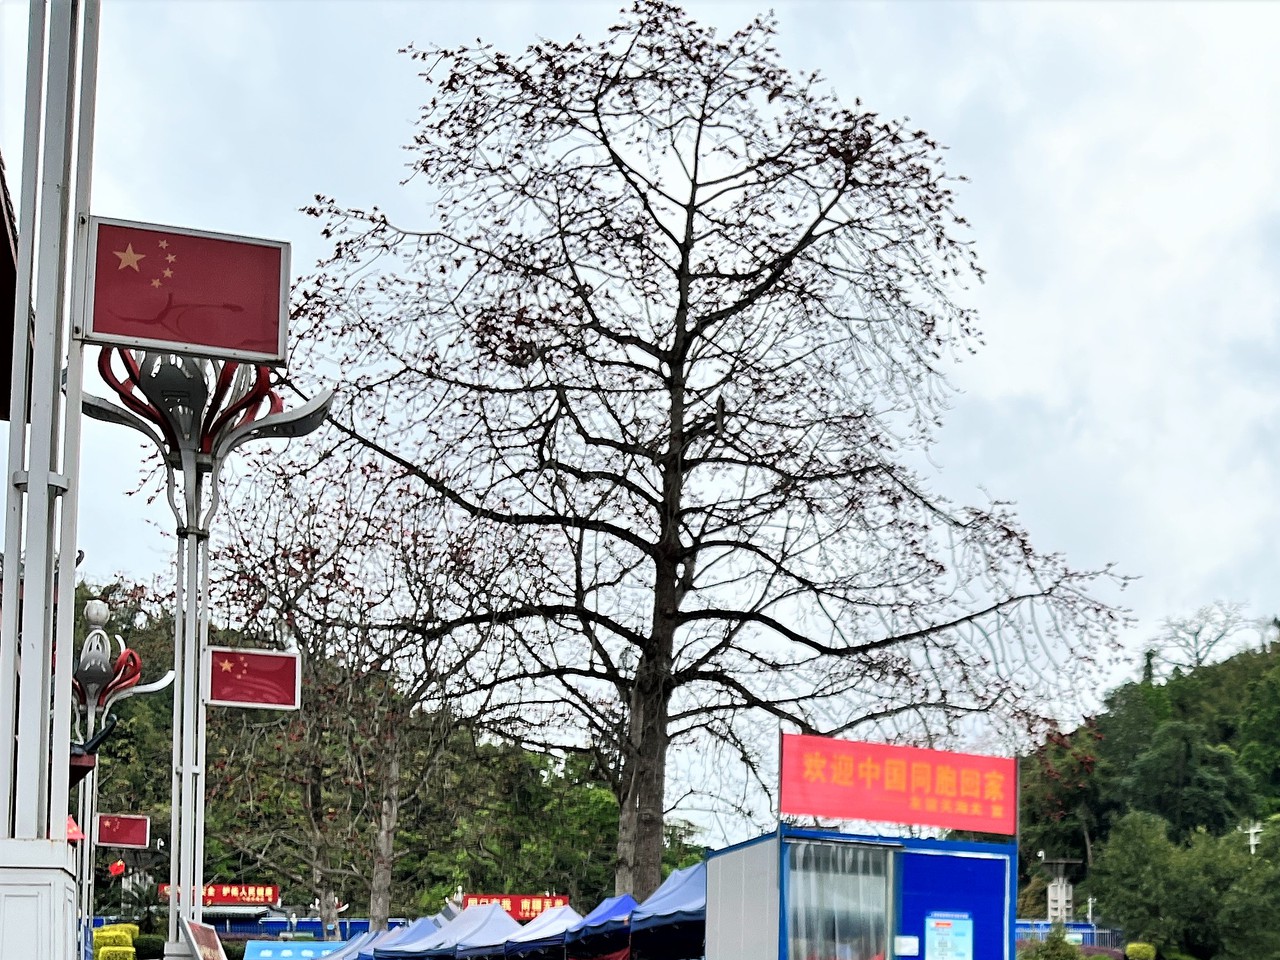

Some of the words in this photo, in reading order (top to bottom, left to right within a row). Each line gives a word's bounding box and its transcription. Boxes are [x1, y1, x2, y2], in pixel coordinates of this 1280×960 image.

[803, 752, 1005, 801] 欢迎中国同胞回家
